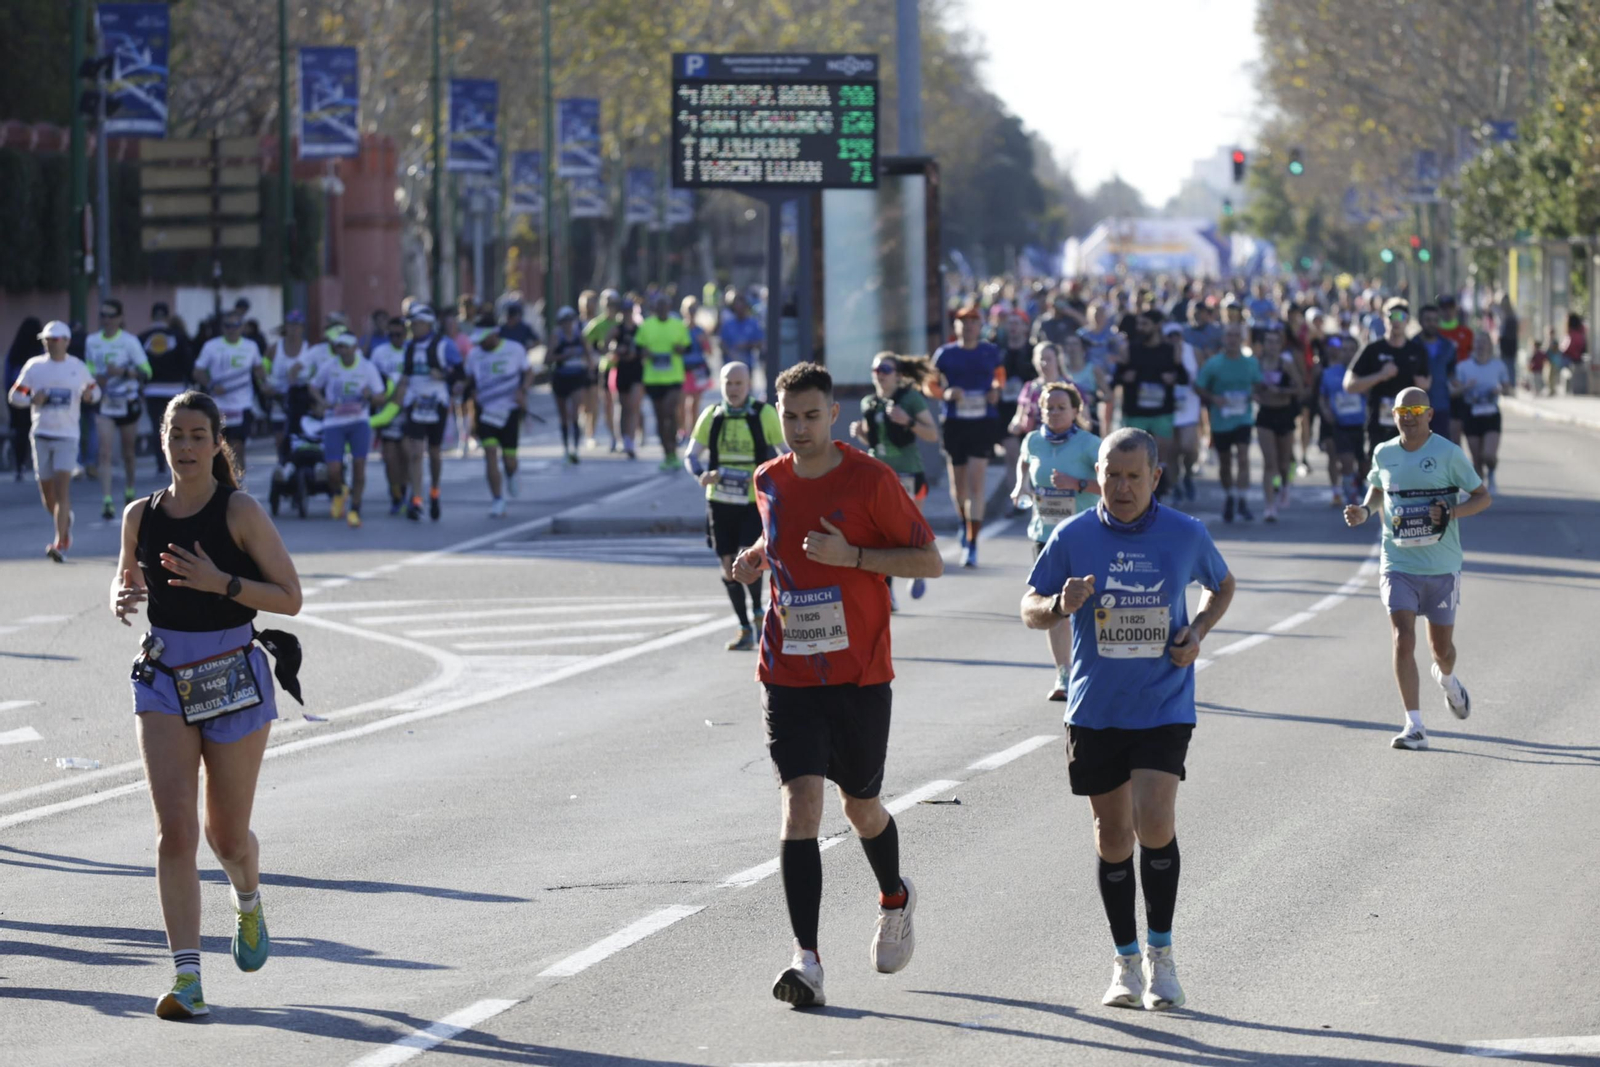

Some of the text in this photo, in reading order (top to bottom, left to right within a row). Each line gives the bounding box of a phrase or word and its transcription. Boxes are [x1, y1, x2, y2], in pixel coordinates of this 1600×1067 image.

[685, 55, 704, 76] P
[1399, 525, 1433, 538] ANDRÉS
[794, 591, 832, 604] ZURICH
[1120, 595, 1161, 606] ZURICH
[795, 612, 821, 623] 11826
[1119, 615, 1146, 625] 11825
[783, 627, 827, 640] ALCODORI
[1099, 627, 1166, 642] ALCODORI
[184, 686, 255, 715] CARLOTA Y JACO
